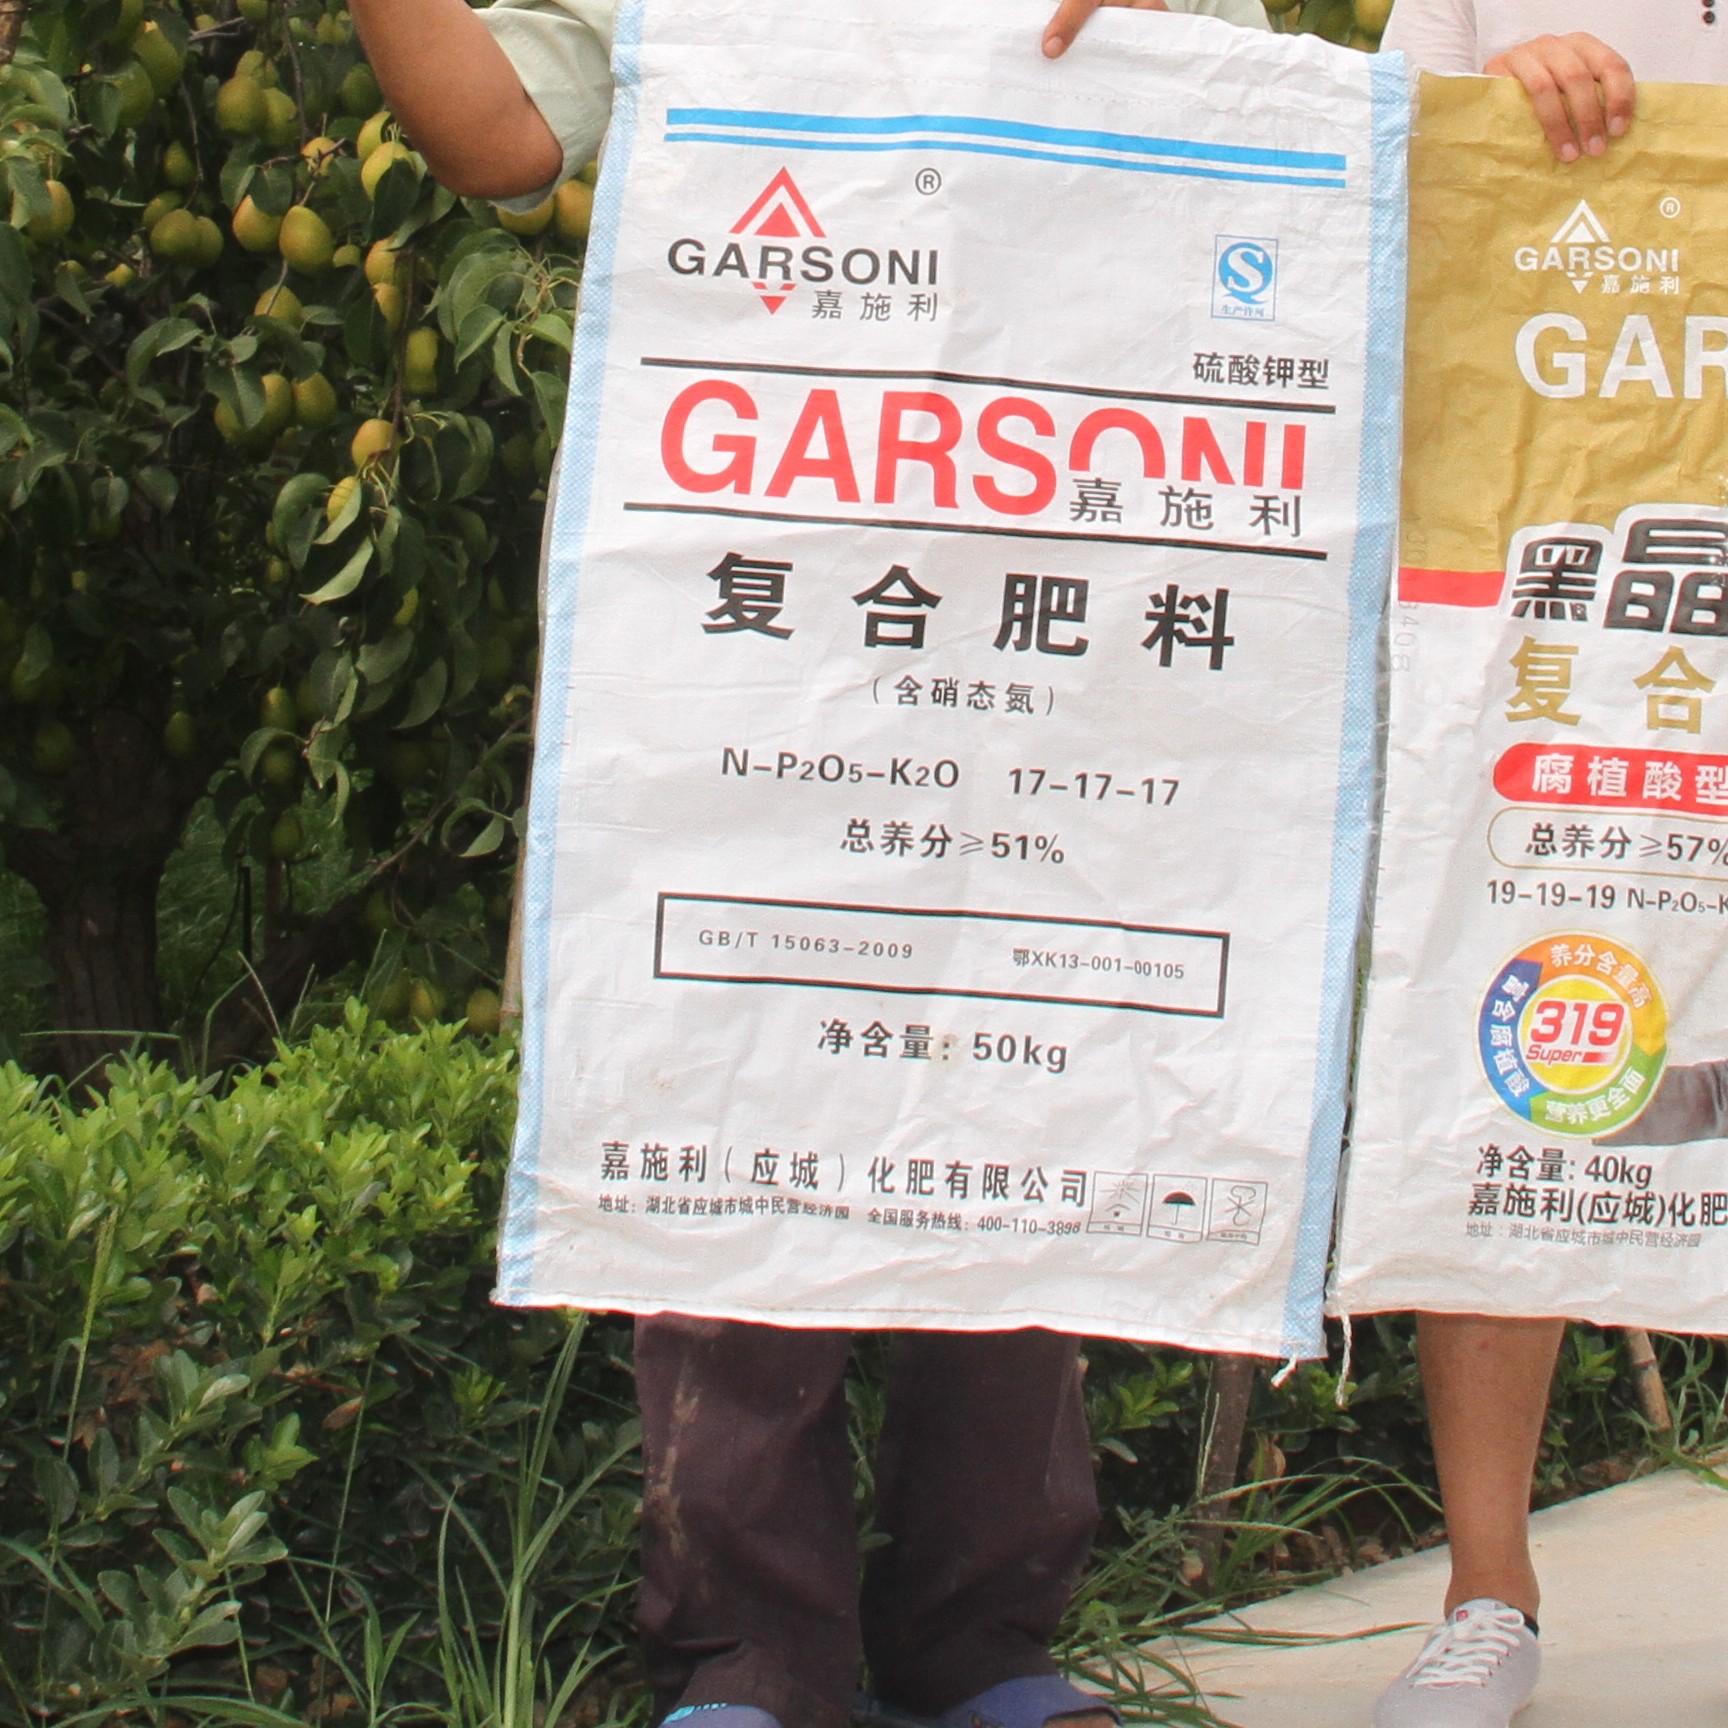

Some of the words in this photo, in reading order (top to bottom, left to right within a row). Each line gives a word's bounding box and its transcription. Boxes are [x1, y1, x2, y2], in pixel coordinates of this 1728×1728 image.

[666, 238, 939, 286] GARSONI
[1514, 246, 1679, 272] GARSONI
[1602, 274, 1680, 294] 嘉施利
[811, 290, 939, 321] 嘉施利
[1193, 352, 1329, 389] 硫酸钾型
[661, 379, 1305, 515] GARSONI
[1070, 478, 1302, 537] 嘉施利
[702, 552, 1235, 670] 复合肥料
[1008, 768, 1180, 807] 17-17-17
[841, 819, 1066, 866] 总养分≥51%
[1487, 879, 1616, 910] 19-19-19
[698, 929, 759, 949] GB/T
[771, 934, 914, 960] 15063-2009
[1550, 943, 1653, 1008] 养分含量高
[1530, 1000, 1624, 1046] 319
[1526, 1044, 1583, 1065] Super
[1545, 1066, 1646, 1124] 营养更全面
